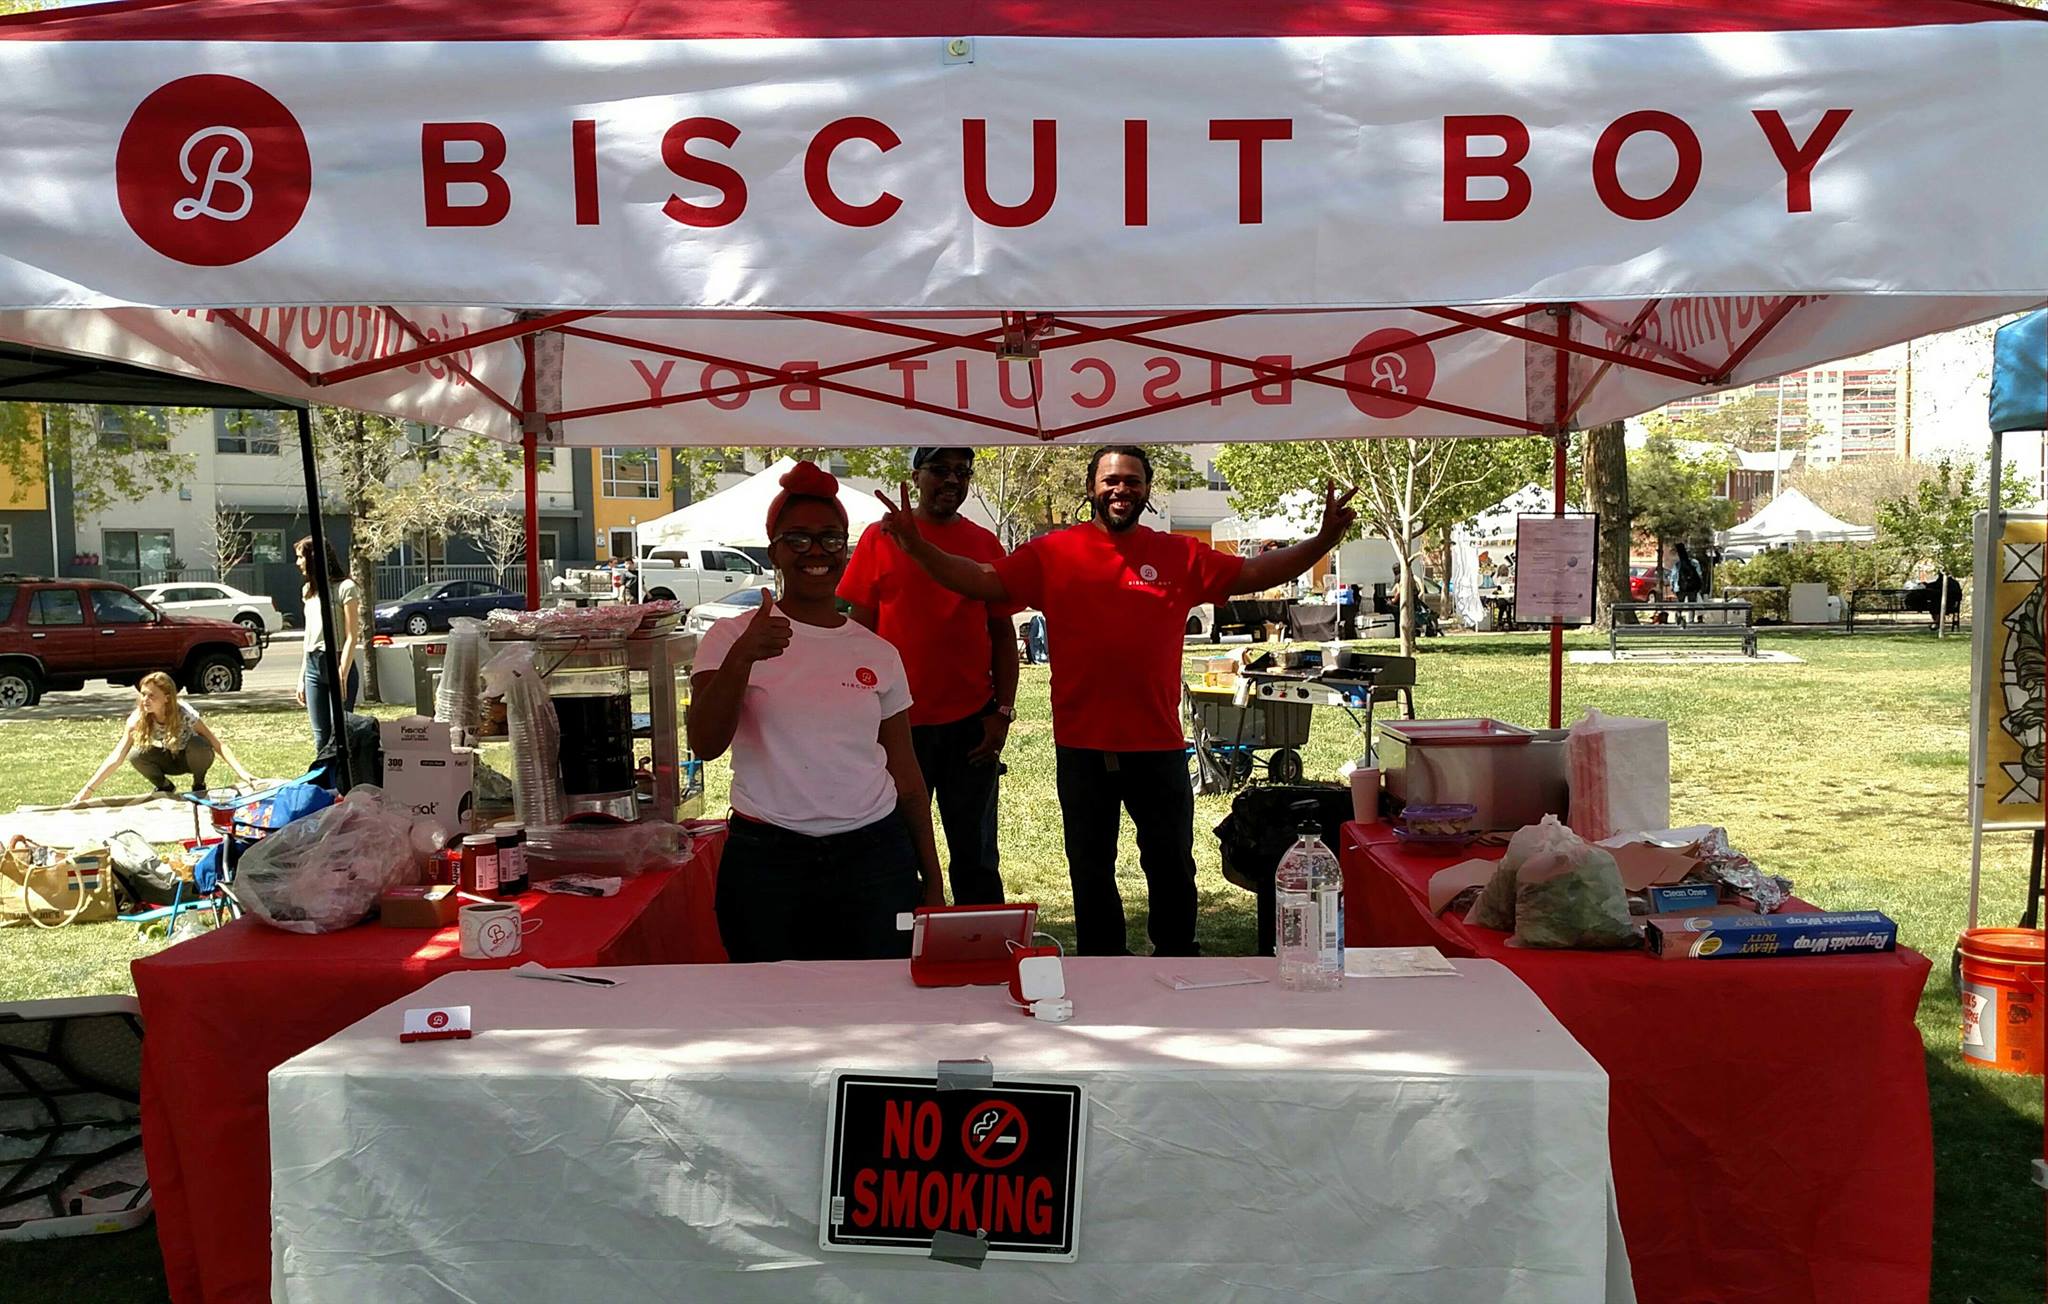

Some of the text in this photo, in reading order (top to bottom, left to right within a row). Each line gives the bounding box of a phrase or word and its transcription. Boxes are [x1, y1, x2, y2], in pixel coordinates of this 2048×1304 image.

[173, 126, 254, 221] B
[421, 109, 1853, 228] BISCUIT BOY
[387, 758, 403, 767] 300
[1661, 887, 1708, 899] Clean Ones
[1785, 911, 1881, 926] Reynolds Wrap
[1748, 933, 1777, 943] DUTY
[1793, 933, 1889, 952] Reynolds Wrap
[1742, 942, 1781, 953] HEAVY
[882, 1099, 943, 1162] NO
[851, 1167, 1054, 1236] SMOKING
